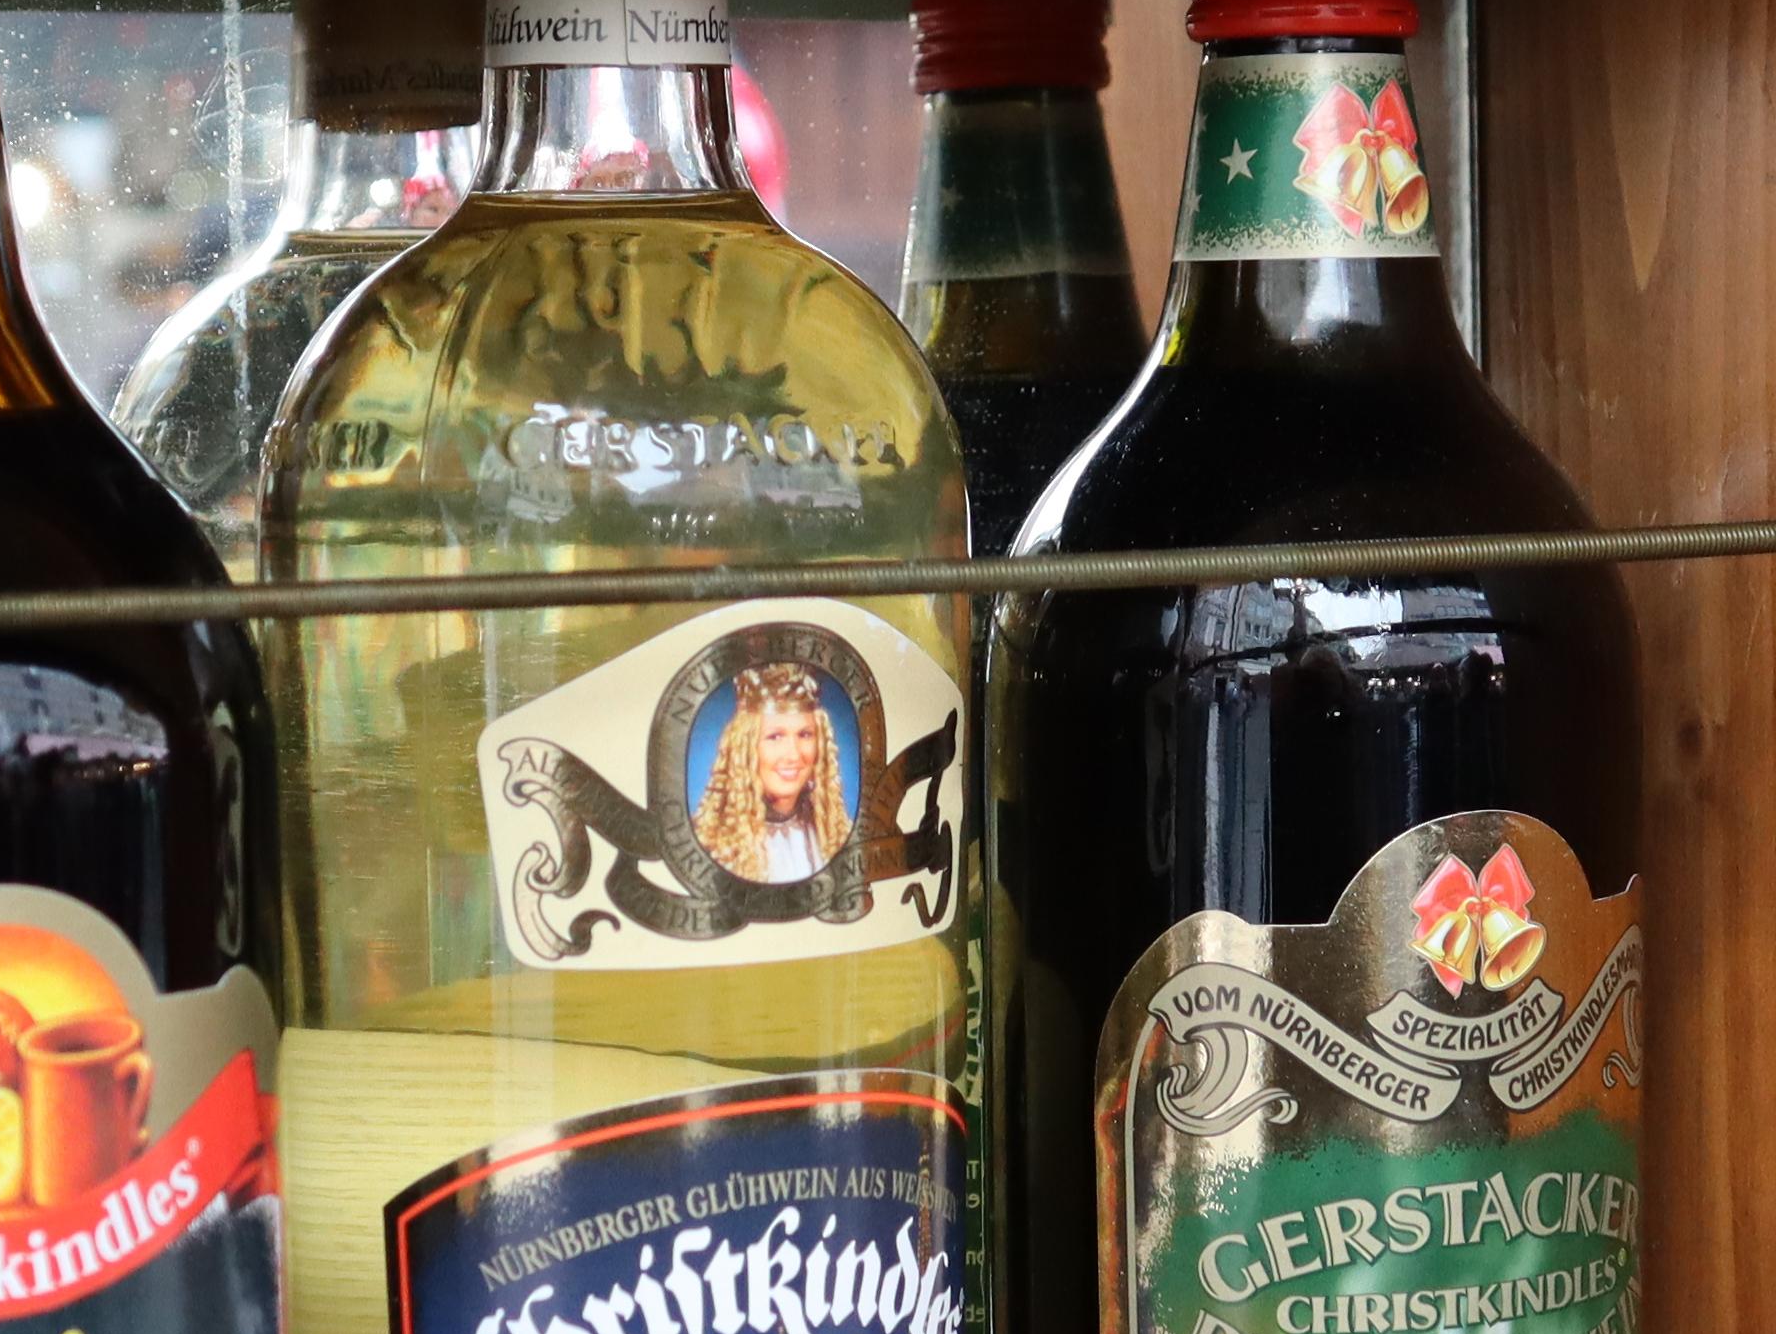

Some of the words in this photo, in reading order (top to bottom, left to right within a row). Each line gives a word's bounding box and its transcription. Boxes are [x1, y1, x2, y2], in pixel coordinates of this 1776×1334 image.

[1172, 985, 1241, 1020] VOM
[1248, 990, 1432, 1112] NÜRNBERGER
[1390, 992, 1549, 1052] SPEZIALITÄT
[479, 1192, 681, 1293] NÜRNBERGER
[685, 1167, 839, 1220] GLÜHWEIN
[844, 1169, 885, 1199] AUS
[1197, 1170, 1640, 1307] GERSTACKER
